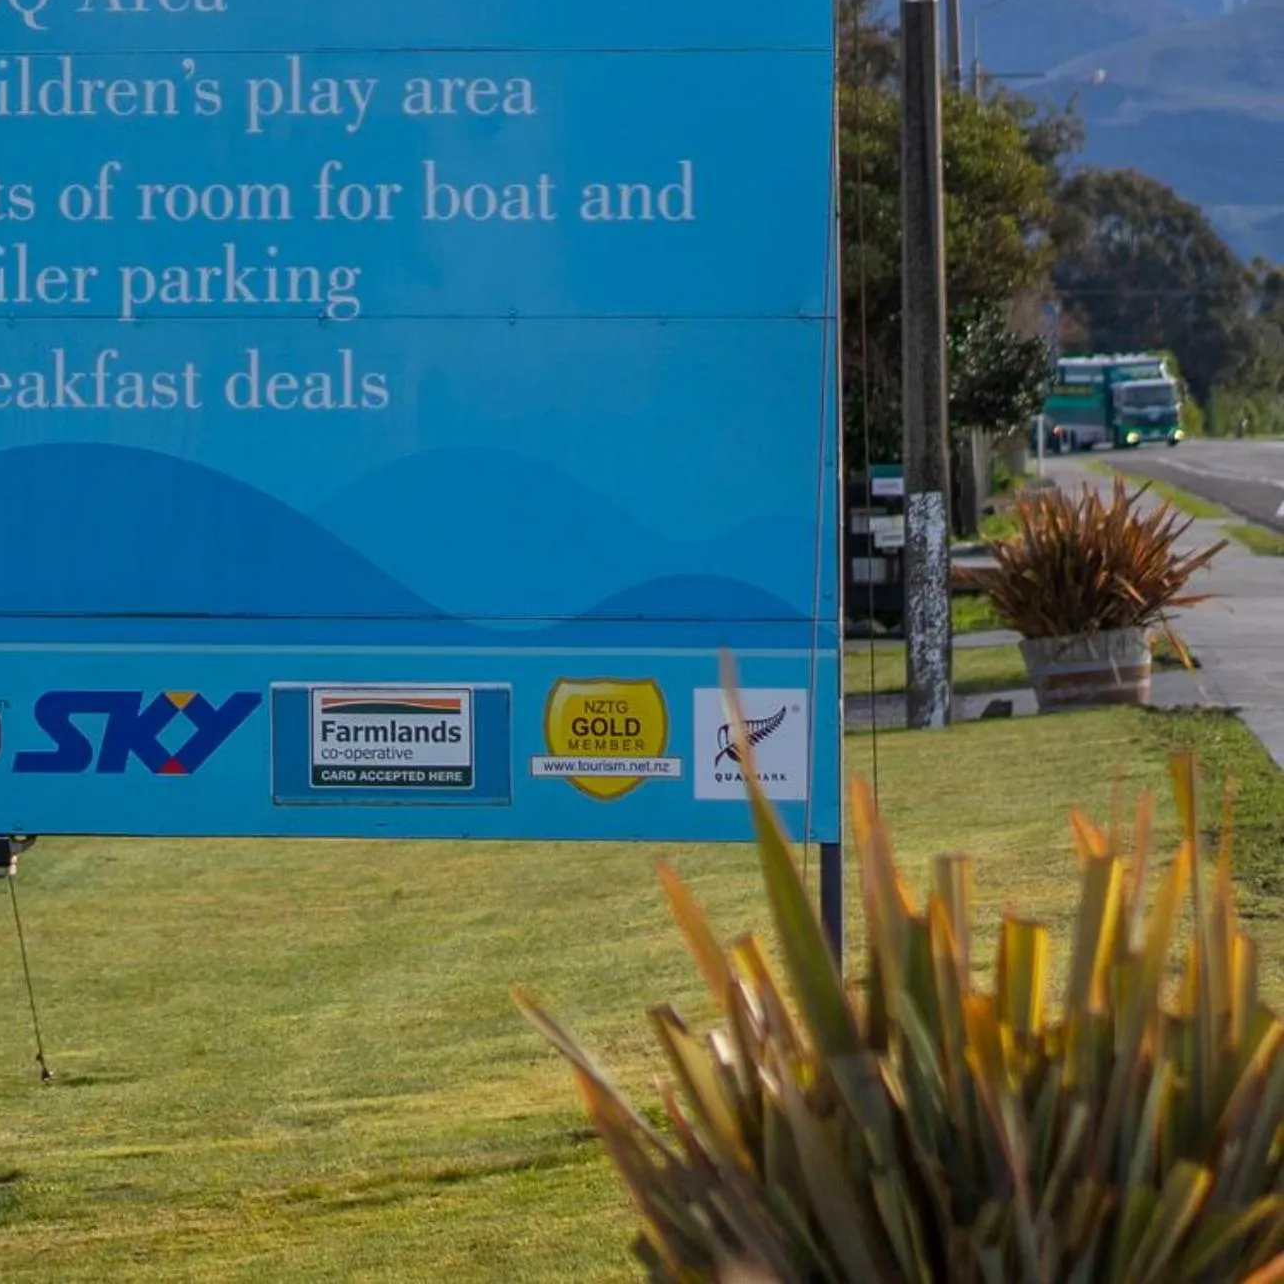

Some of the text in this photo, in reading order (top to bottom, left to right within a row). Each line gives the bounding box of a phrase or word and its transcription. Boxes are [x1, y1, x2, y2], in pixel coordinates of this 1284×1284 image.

[245, 54, 377, 133] play
[402, 77, 537, 115] area
[58, 161, 122, 221] of
[137, 184, 292, 221] room
[315, 160, 402, 220] for
[422, 160, 556, 221] boat
[579, 159, 695, 222] and
[118, 243, 361, 319] parking
[224, 348, 390, 411] deals
[583, 701, 628, 715] NZTG
[12, 691, 262, 774] SKY
[321, 720, 461, 743] Farmlands
[571, 717, 640, 737] GOLD
[321, 746, 414, 762] co-operative
[567, 739, 645, 751] MEMBER
[321, 770, 463, 782] CARD ACCEPTED HERE
[543, 759, 670, 773] www.tourism.net.nz
[715, 773, 787, 783] QUAARK
